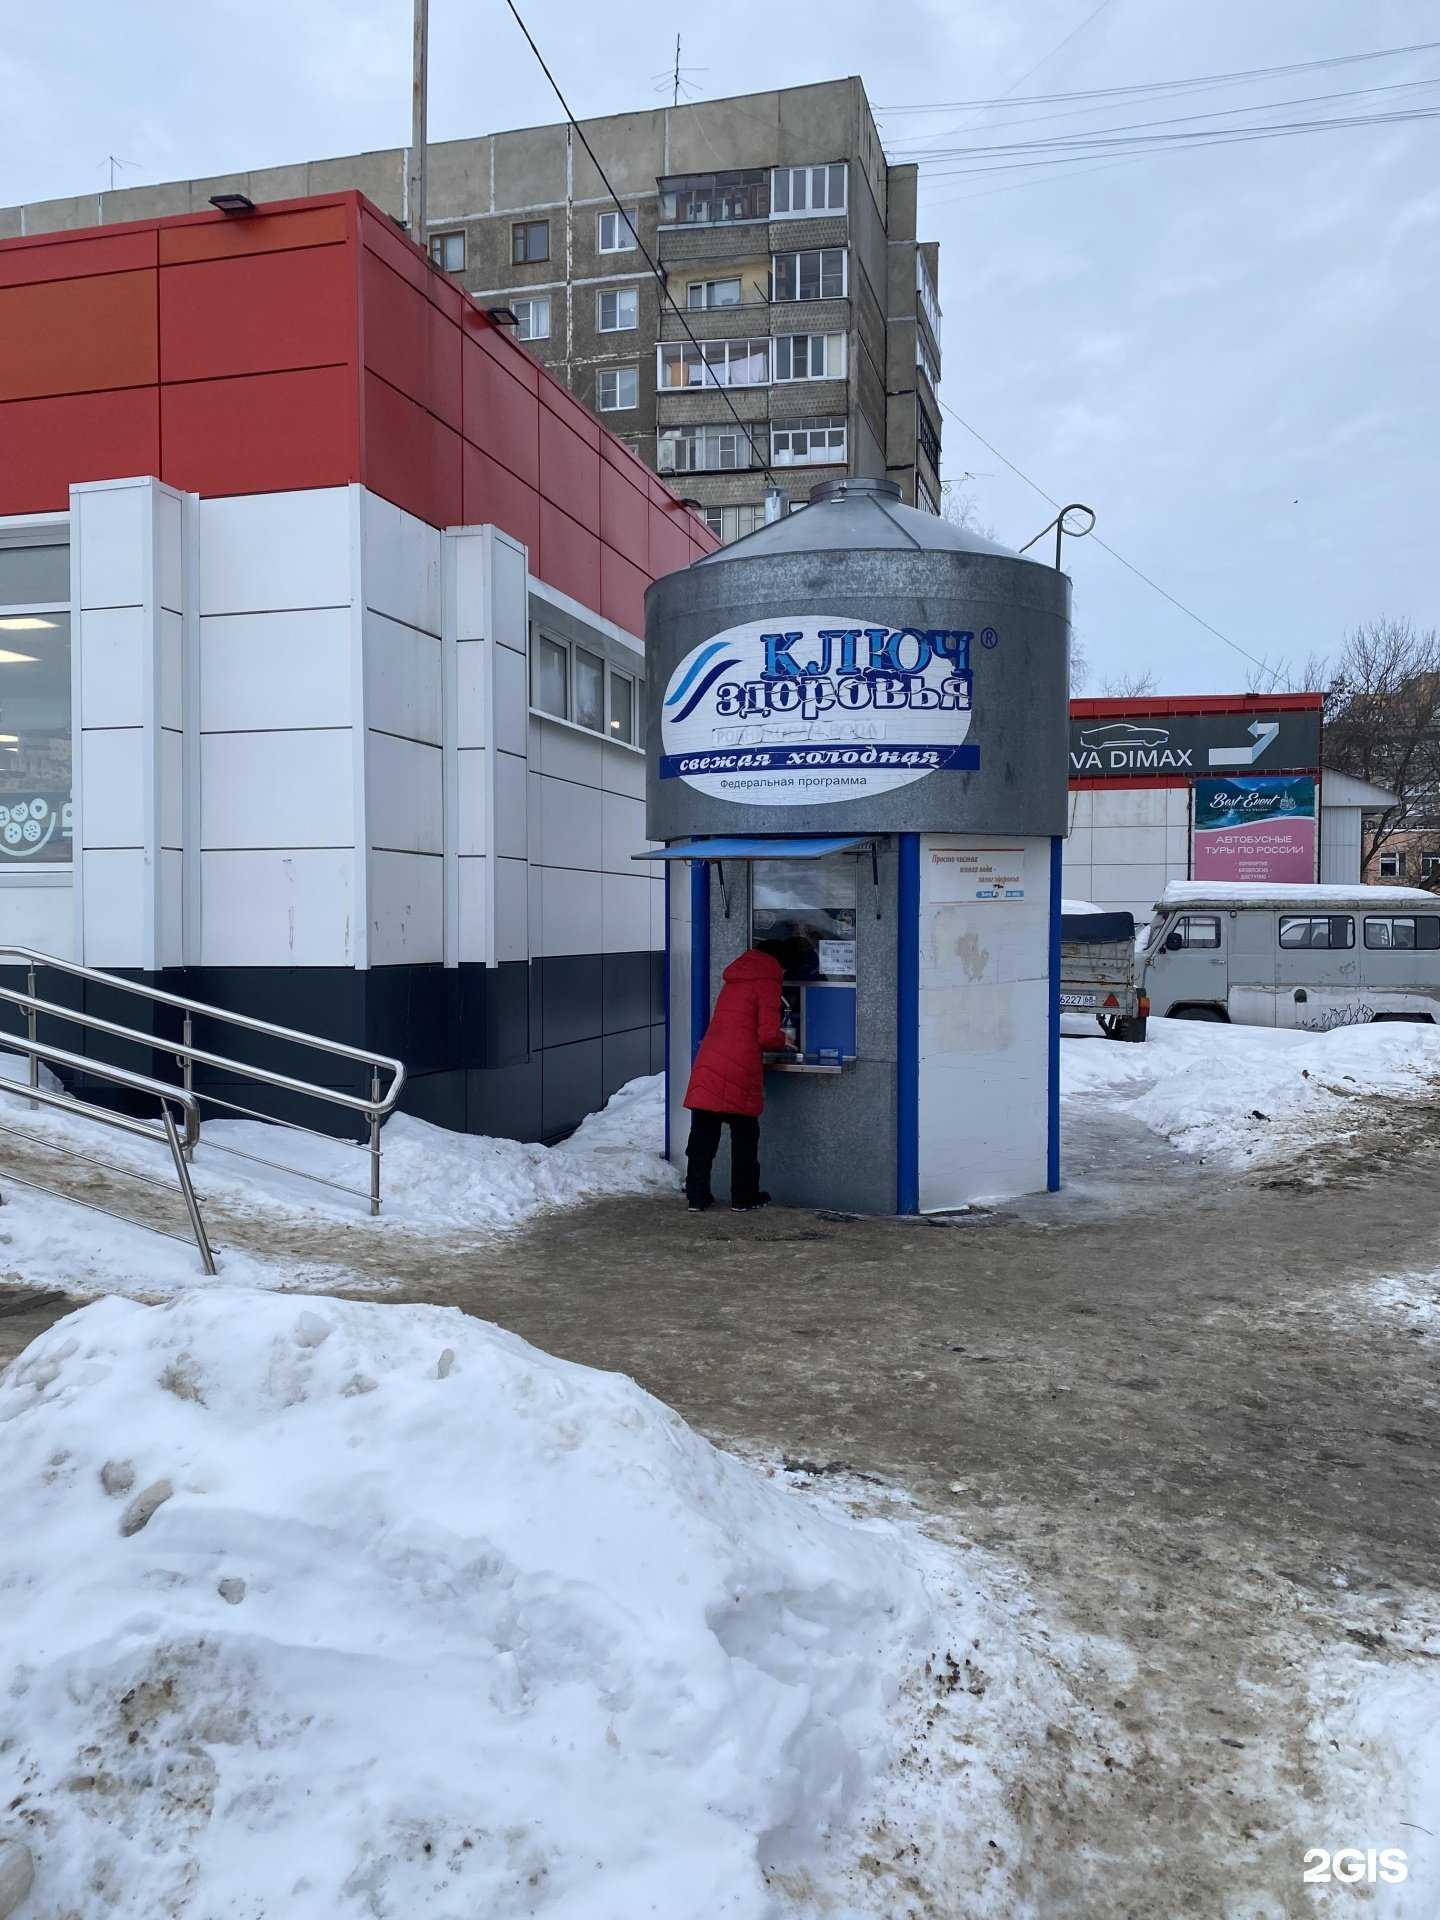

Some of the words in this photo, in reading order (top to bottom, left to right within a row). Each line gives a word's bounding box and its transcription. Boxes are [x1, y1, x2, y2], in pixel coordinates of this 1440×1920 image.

[760, 628, 974, 680] КЛЮЧ
[716, 675, 972, 720] здоровья
[680, 753, 771, 771] свежая
[787, 745, 939, 764] холодная
[1111, 749, 1193, 768] DIMAX
[720, 776, 794, 789] Федеральная
[799, 776, 867, 788] программа
[1209, 792, 1244, 808] Best
[1243, 792, 1280, 808] Event
[1216, 835, 1293, 844] АВТОБУСНЫЕ
[1205, 846, 1235, 855] ТУРЫ
[1238, 846, 1254, 854] ПО
[1257, 846, 1304, 854] РОССИИ
